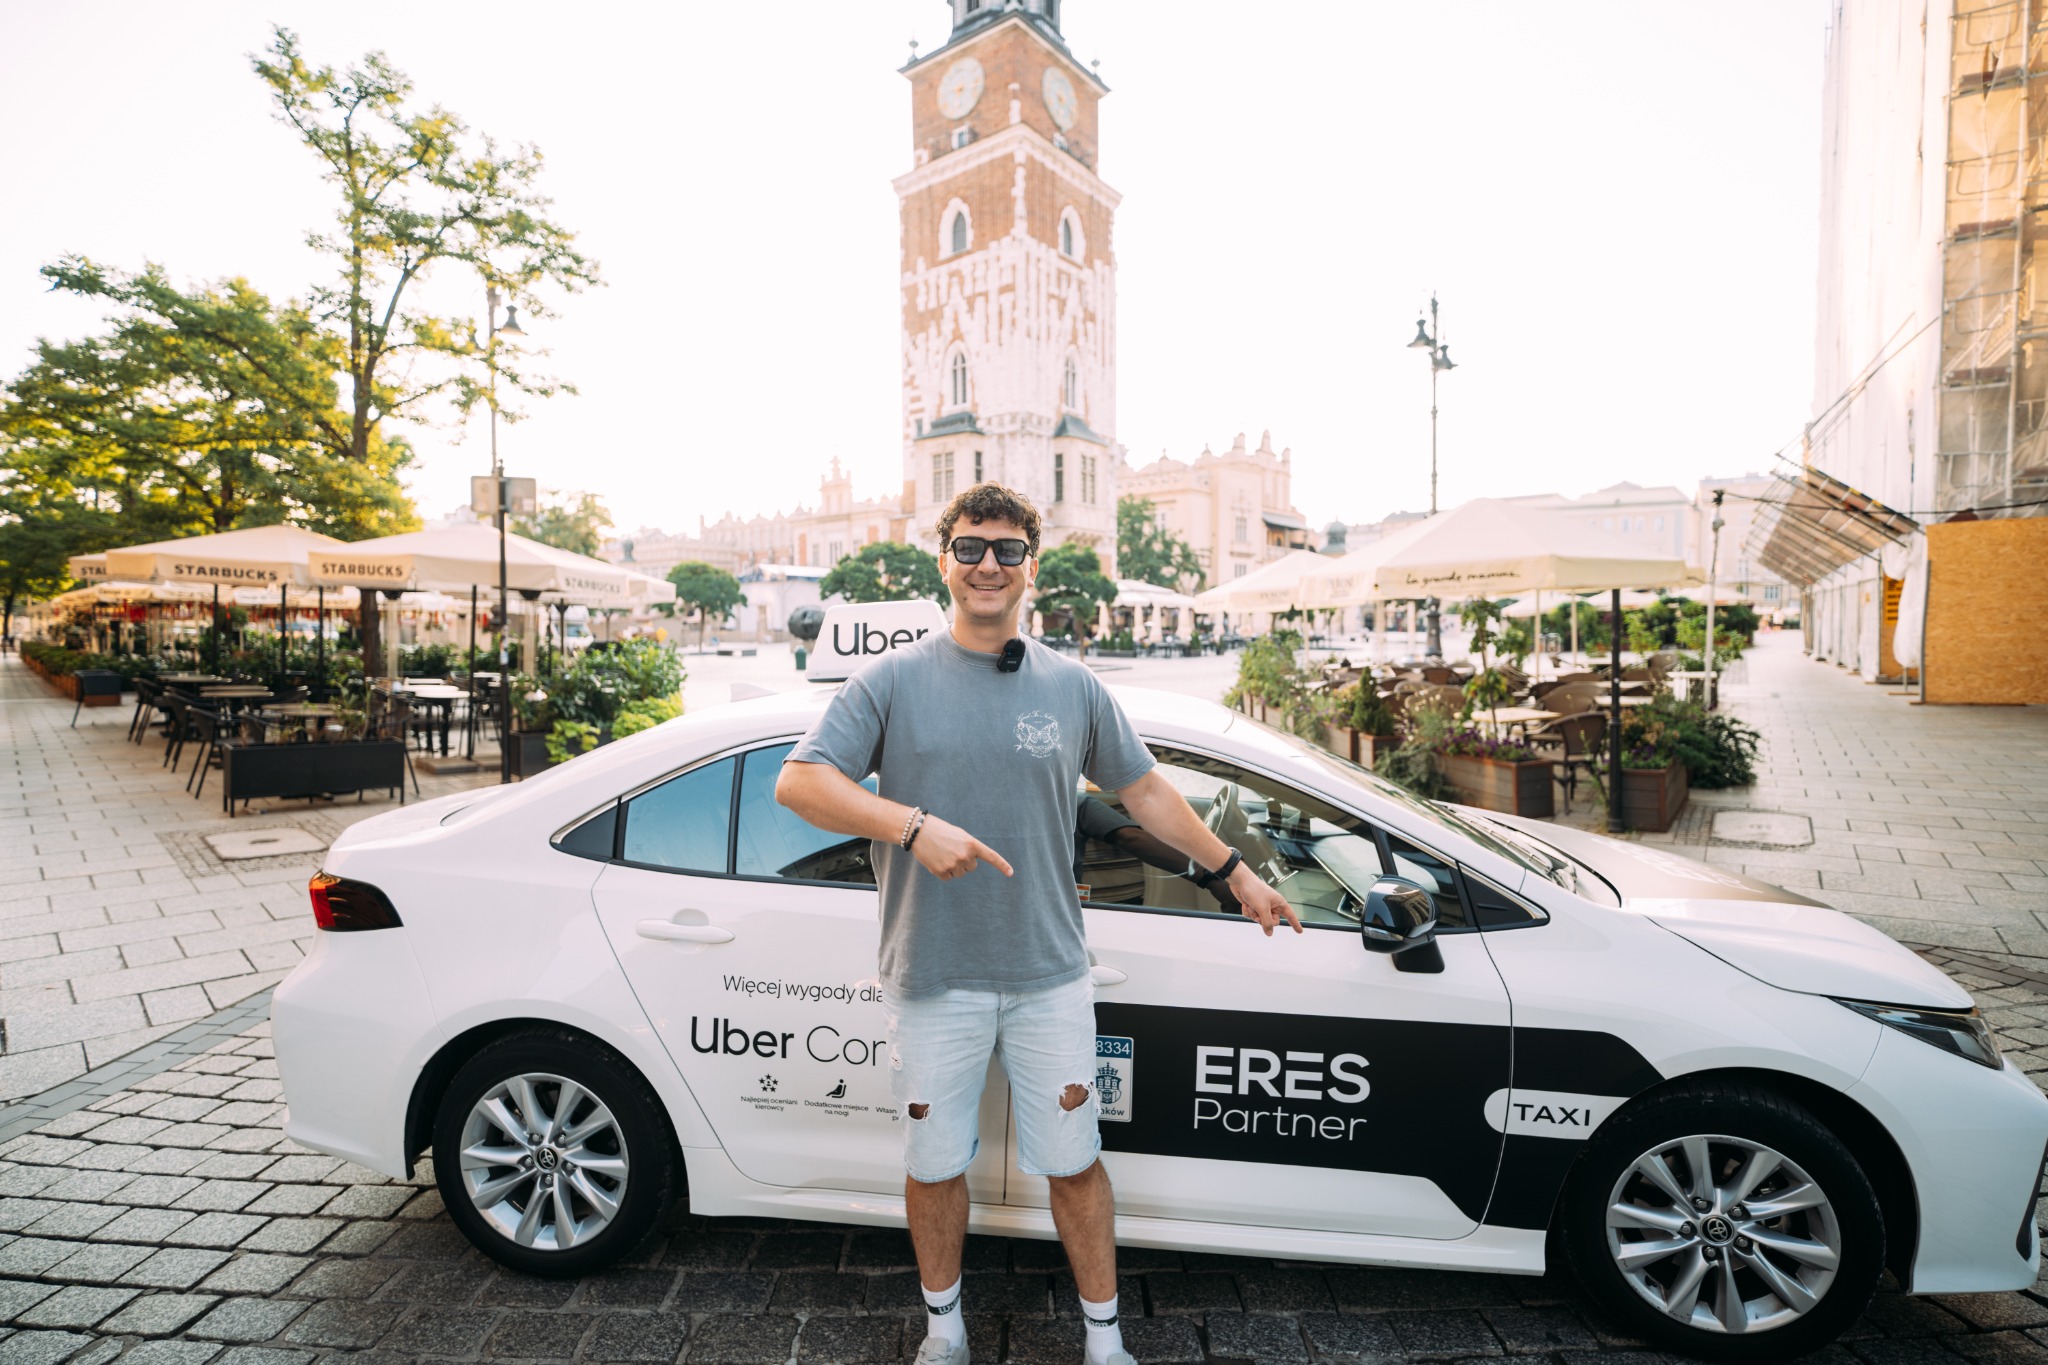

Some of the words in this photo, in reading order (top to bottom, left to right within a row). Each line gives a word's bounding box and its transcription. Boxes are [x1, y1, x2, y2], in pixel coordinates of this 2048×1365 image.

[174, 563, 278, 581] STARBUCKS
[322, 562, 404, 577] STARBUCKS
[565, 578, 621, 593] STARBUCKS
[833, 622, 929, 656] Uber
[723, 974, 782, 998] Więcej
[785, 983, 856, 1004] wygody
[690, 1015, 795, 1059] Uber
[1195, 1045, 1371, 1103] ERES
[740, 1095, 770, 1104] Najlepiej
[770, 1097, 798, 1105] oceniani
[754, 1103, 785, 1112] kierowcy
[804, 1099, 842, 1110] Dodatkowe
[843, 1103, 869, 1112] miejsce
[834, 1109, 850, 1117] nogi
[1193, 1097, 1368, 1141] Partner
[1512, 1103, 1591, 1127] TAXI
